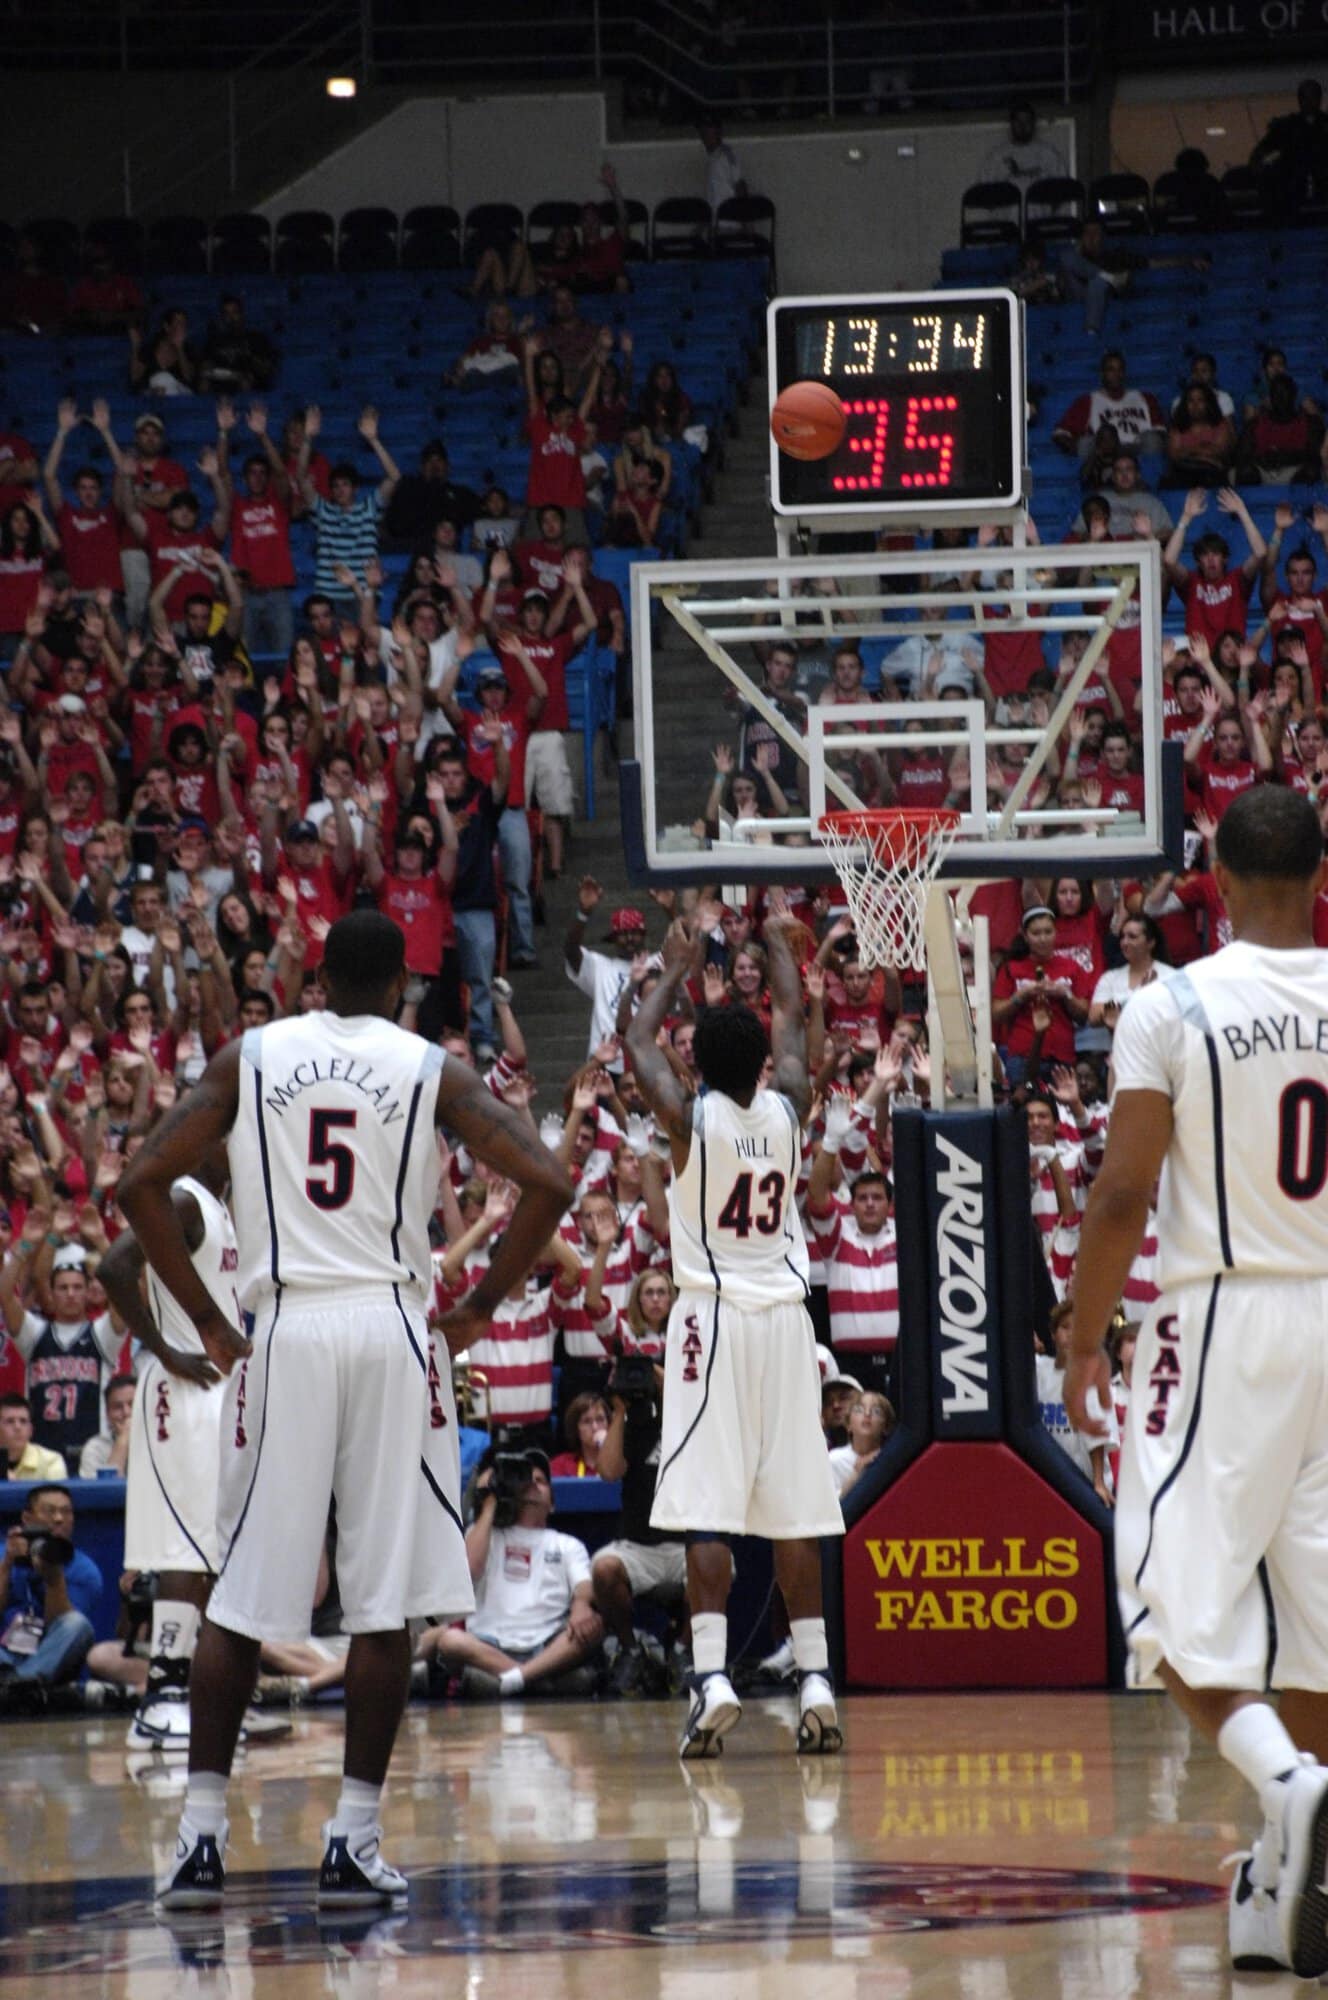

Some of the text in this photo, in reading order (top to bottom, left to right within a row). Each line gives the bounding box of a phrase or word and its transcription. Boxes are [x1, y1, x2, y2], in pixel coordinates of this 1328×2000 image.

[1153, 5, 1245, 37] HALL
[1260, 1, 1303, 30] OF
[823, 315, 985, 376] 13:34
[833, 395, 957, 490] 35
[1222, 1014, 1328, 1061] BAYLE
[306, 1107, 357, 1212] 5
[735, 1137, 774, 1158] HILL
[1277, 1077, 1328, 1202] 0
[718, 1170, 785, 1239] 43
[935, 1131, 989, 1413] ARIZONA
[682, 1315, 702, 1382] CATS
[1146, 1315, 1181, 1436] CATS
[43, 1383, 77, 1421] 21
[155, 1380, 171, 1443] CATS
[865, 1537, 1080, 1578] WELLS
[874, 1588, 1078, 1631] FARGO
